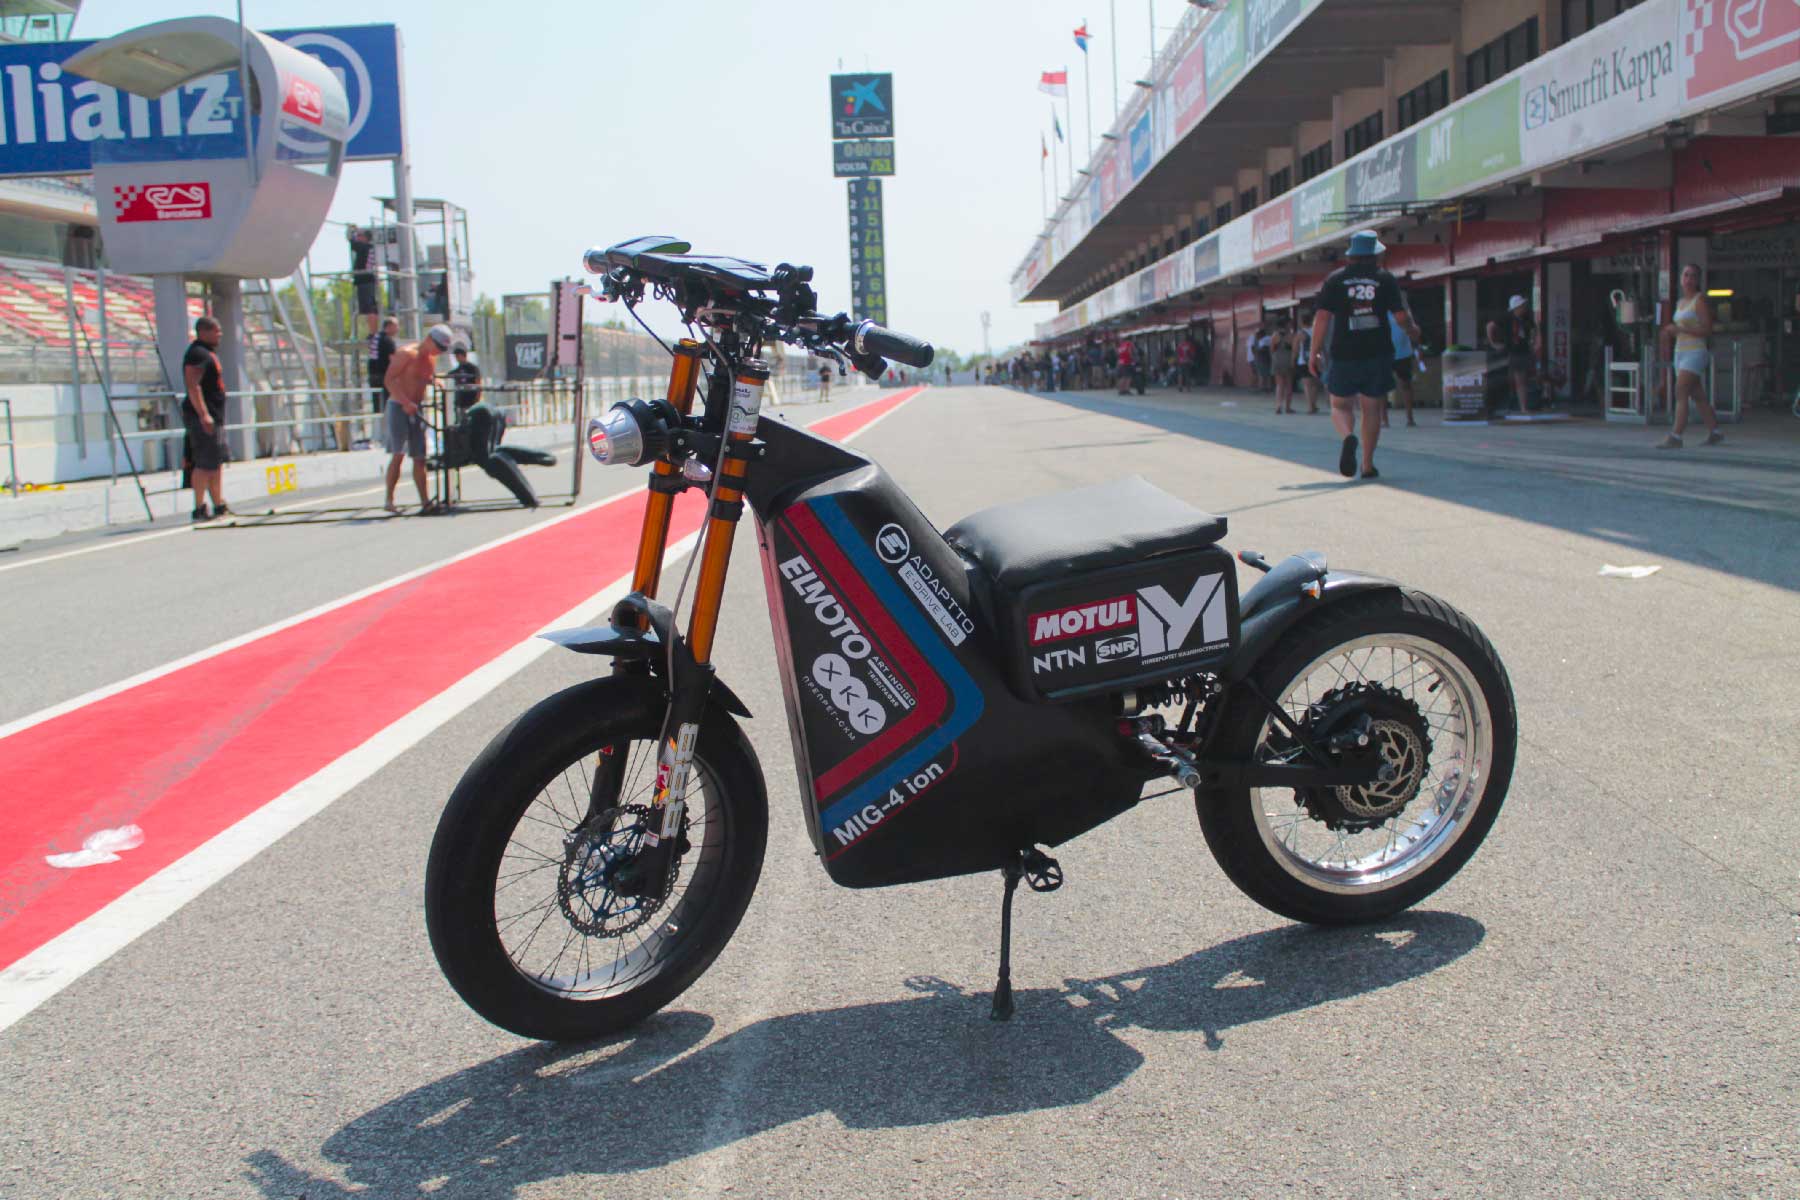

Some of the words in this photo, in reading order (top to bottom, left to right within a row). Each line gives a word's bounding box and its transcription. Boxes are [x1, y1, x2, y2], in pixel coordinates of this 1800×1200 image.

[1548, 56, 1609, 122] Smurfit
[1612, 40, 1673, 103] Kappa
[835, 162, 869, 172] VOLTA
[156, 208, 204, 220] Barcelona
[863, 196, 880, 210] 11
[778, 554, 872, 660] ELMOTO
[905, 569, 941, 615] E-DRIVE
[941, 615, 960, 639] LAB
[909, 555, 975, 634] ADAPTTO
[1034, 599, 1133, 641] MOTUL
[1033, 646, 1087, 675] NTN
[1096, 639, 1137, 658] SNR
[871, 655, 890, 673] ART
[887, 673, 916, 706] INDIGO
[832, 787, 905, 847] MIG-4
[902, 762, 945, 795] ion
